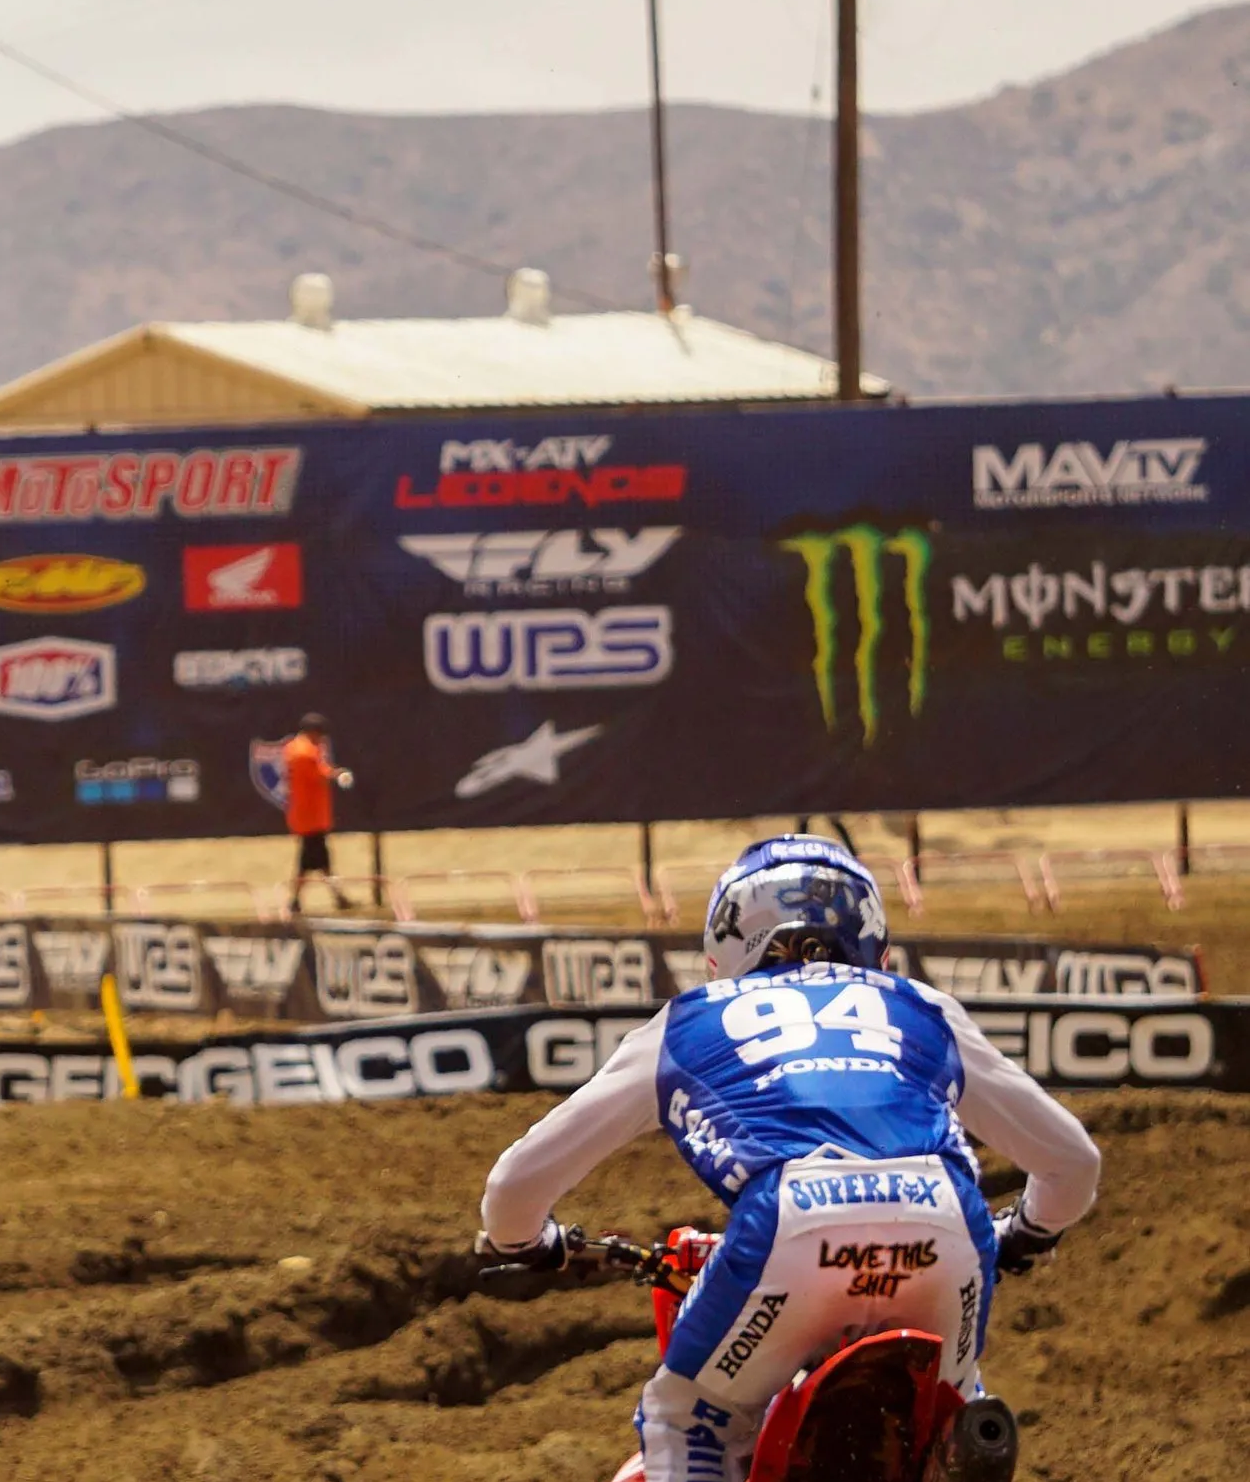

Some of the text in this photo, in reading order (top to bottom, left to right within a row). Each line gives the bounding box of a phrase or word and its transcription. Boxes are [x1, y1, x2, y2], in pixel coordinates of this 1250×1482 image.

[434, 615, 664, 683] WPS
[720, 983, 904, 1066] 94
[964, 1011, 1215, 1080] EICO
[177, 1027, 497, 1107] GEICO
[753, 1055, 907, 1094] HONDA
[818, 1237, 939, 1271] LOVE THIS
[846, 1272, 913, 1300] SHIT
[714, 1291, 789, 1380] HONDA
